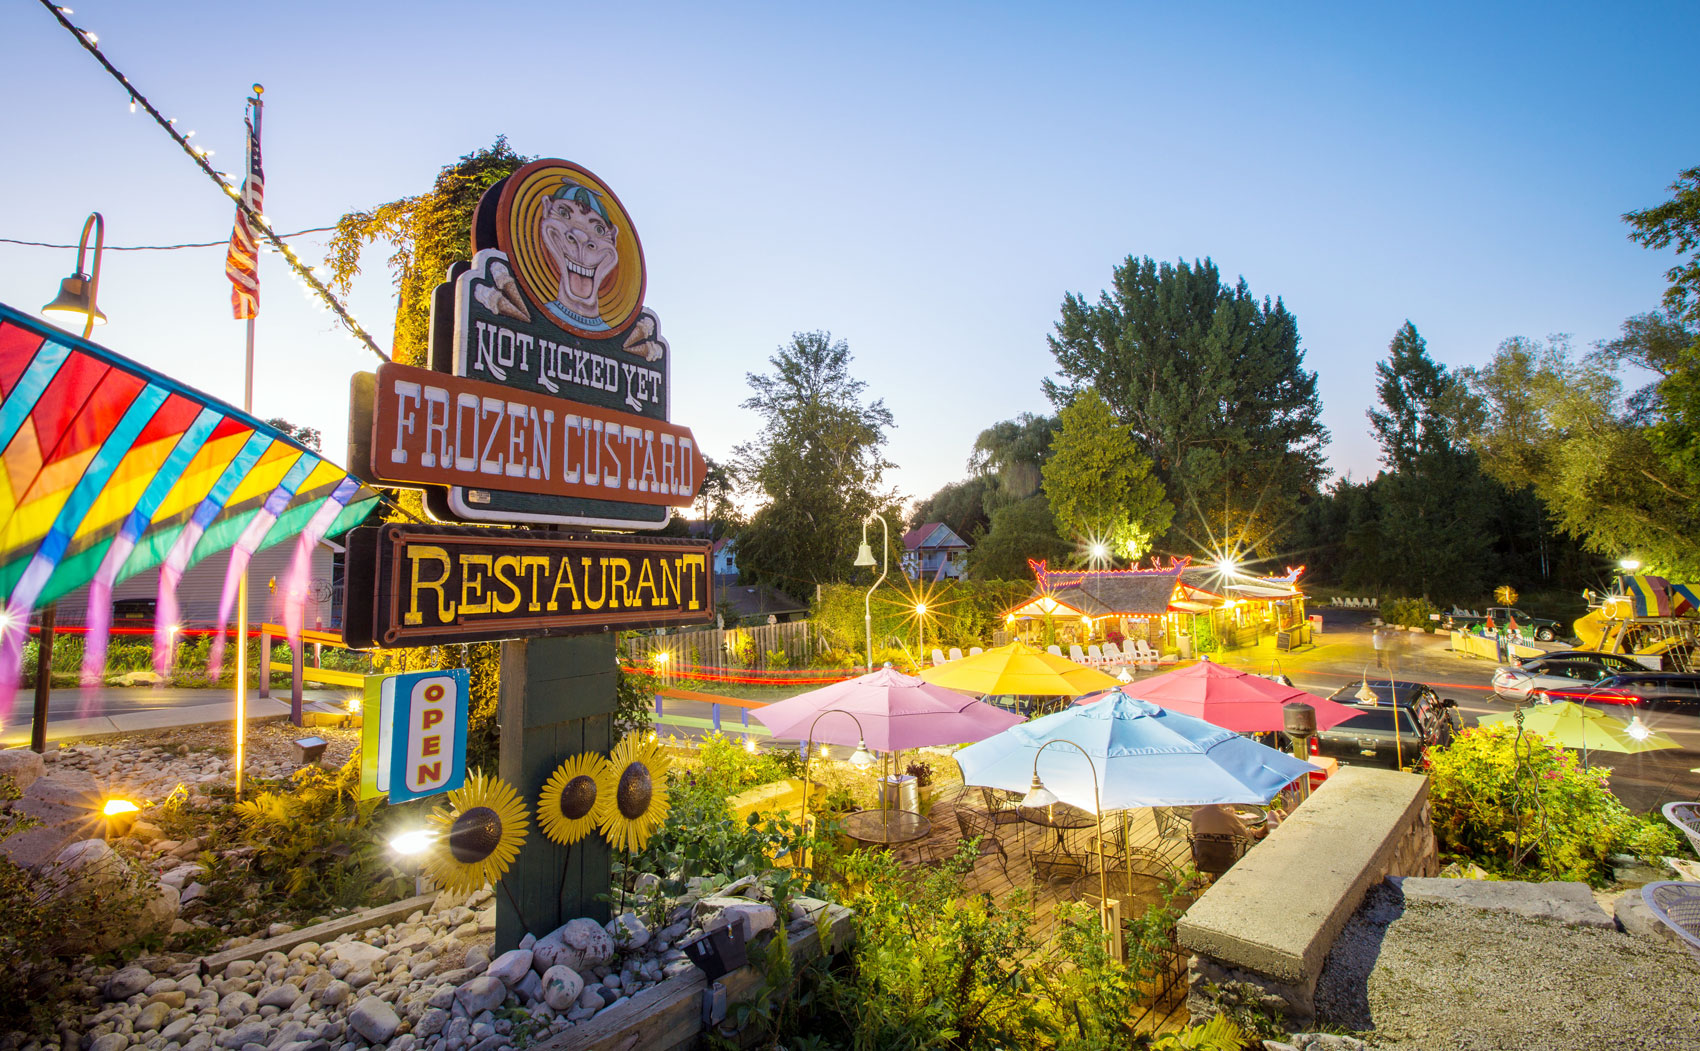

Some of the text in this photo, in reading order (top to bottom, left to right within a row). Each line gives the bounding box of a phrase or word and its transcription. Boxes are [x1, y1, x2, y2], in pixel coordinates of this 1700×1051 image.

[474, 321, 662, 412] NOT LICKED YET
[391, 380, 694, 497] FROZEN CUSTARD
[404, 545, 705, 625] RESTAURANT
[417, 684, 445, 786] OPEN
